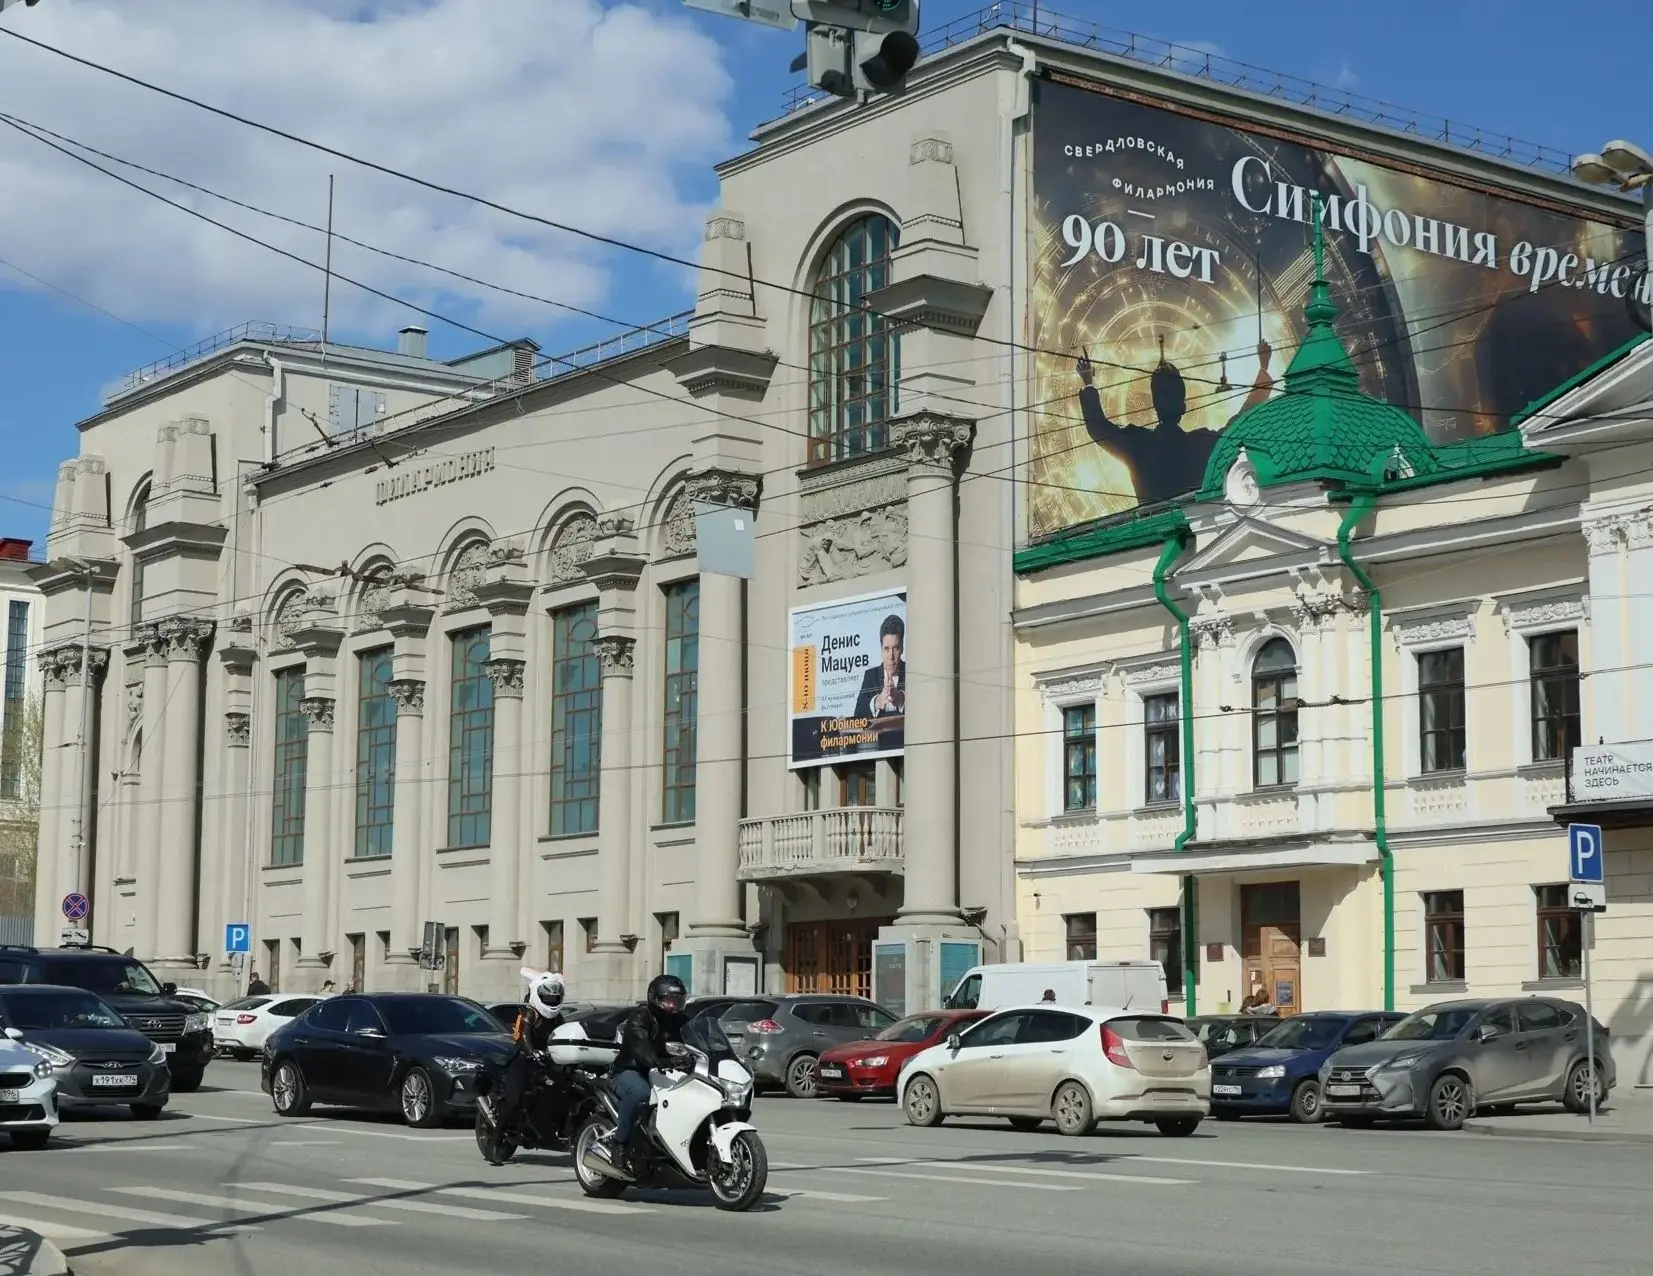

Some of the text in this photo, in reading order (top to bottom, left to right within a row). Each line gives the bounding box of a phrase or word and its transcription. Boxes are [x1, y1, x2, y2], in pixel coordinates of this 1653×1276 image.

[1064, 137, 1184, 170] СВЕРДЛОВСКАЯ
[1112, 177, 1214, 200] ФИЛАРМОНИЯ
[1231, 155, 1499, 270] Симфония
[1060, 214, 1220, 284] 90 лет
[821, 633, 861, 655] Денис
[821, 654, 869, 673] Мацуев
[820, 717, 868, 733] К Юбилею
[820, 731, 879, 751] филармонии
[1584, 754, 1614, 766] ТЕАТР
[1584, 762, 1652, 777] НАЧИНАЕТСЯ
[1584, 776, 1620, 788] ЗДЕСЬ
[1576, 830, 1595, 874] P
[232, 927, 245, 948] P
